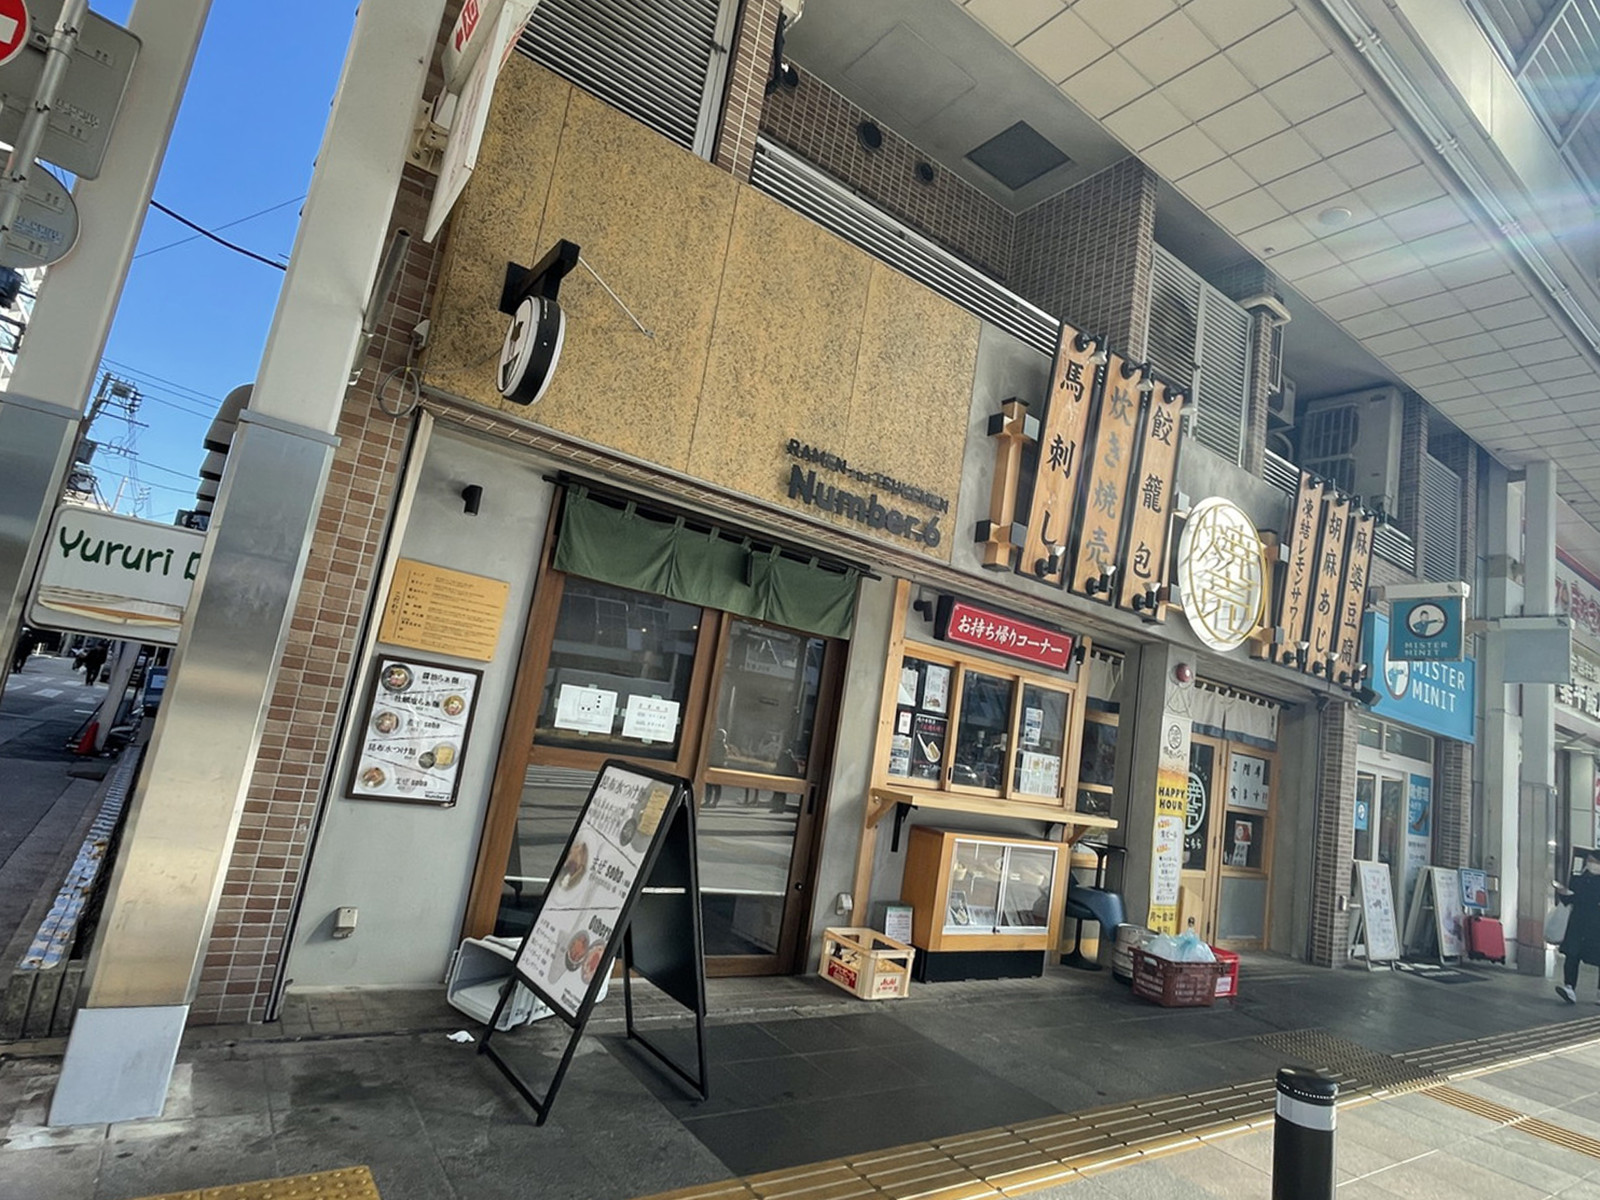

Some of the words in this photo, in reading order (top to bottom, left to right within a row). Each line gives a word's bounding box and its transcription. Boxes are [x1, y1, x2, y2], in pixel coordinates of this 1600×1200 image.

[787, 438, 848, 474] RAMEN
[1041, 359, 1085, 546] 馬刺し
[1085, 386, 1133, 573] 炊き焼売
[1133, 405, 1174, 580] 餃籠包
[59, 526, 175, 577] Yururi
[1288, 499, 1314, 640] 凍結レモンサワー
[1315, 512, 1343, 653] 胡麻あじ
[1338, 528, 1368, 666] 麻婆豆腐
[957, 614, 1063, 654] お持ち帰りコーナー
[1404, 641, 1448, 649] MISTER
[1412, 679, 1456, 713] MINIT
[1413, 660, 1465, 692] MISTER
[1158, 787, 1185, 798] HAPPY
[1159, 799, 1182, 810] HOUR
